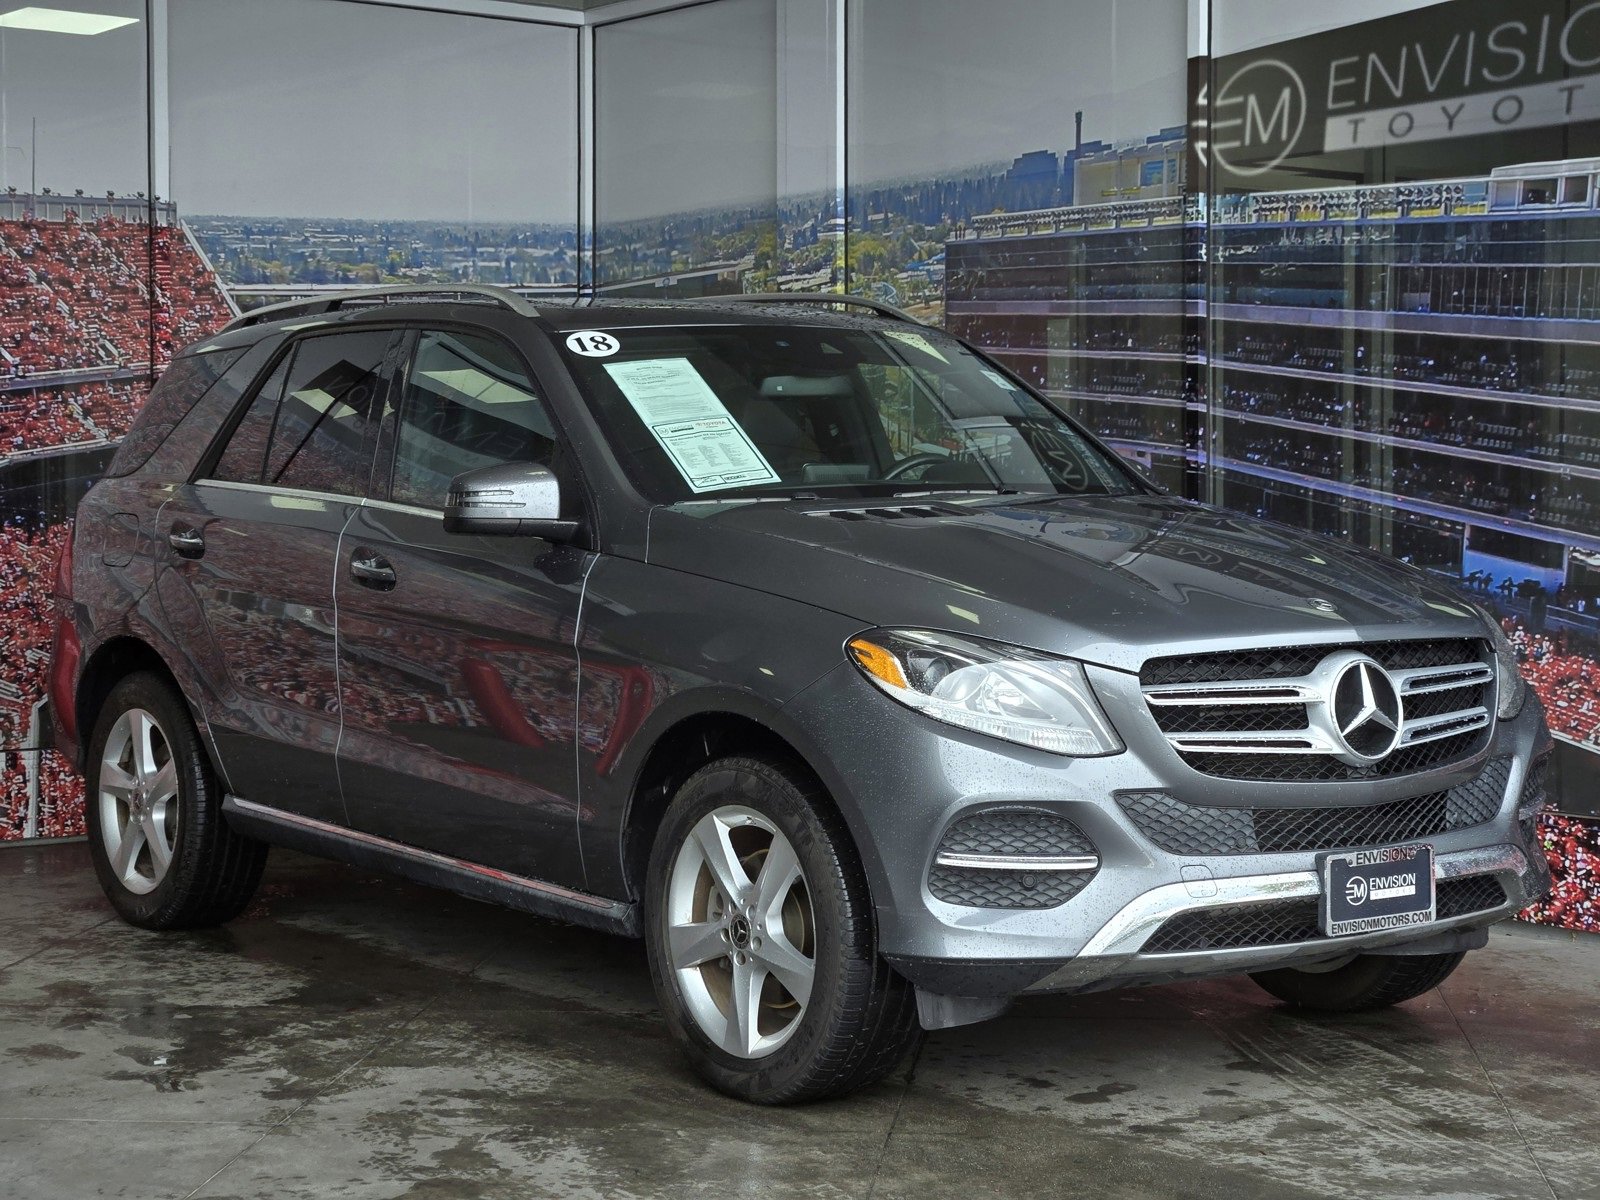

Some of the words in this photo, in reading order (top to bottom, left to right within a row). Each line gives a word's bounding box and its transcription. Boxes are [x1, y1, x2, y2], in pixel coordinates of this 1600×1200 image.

[571, 335, 613, 353] 18
[1356, 848, 1408, 866] ENVISION
[1369, 873, 1416, 890] ENVISION
[1331, 911, 1432, 935] ENVISIONMOTORS.COM
